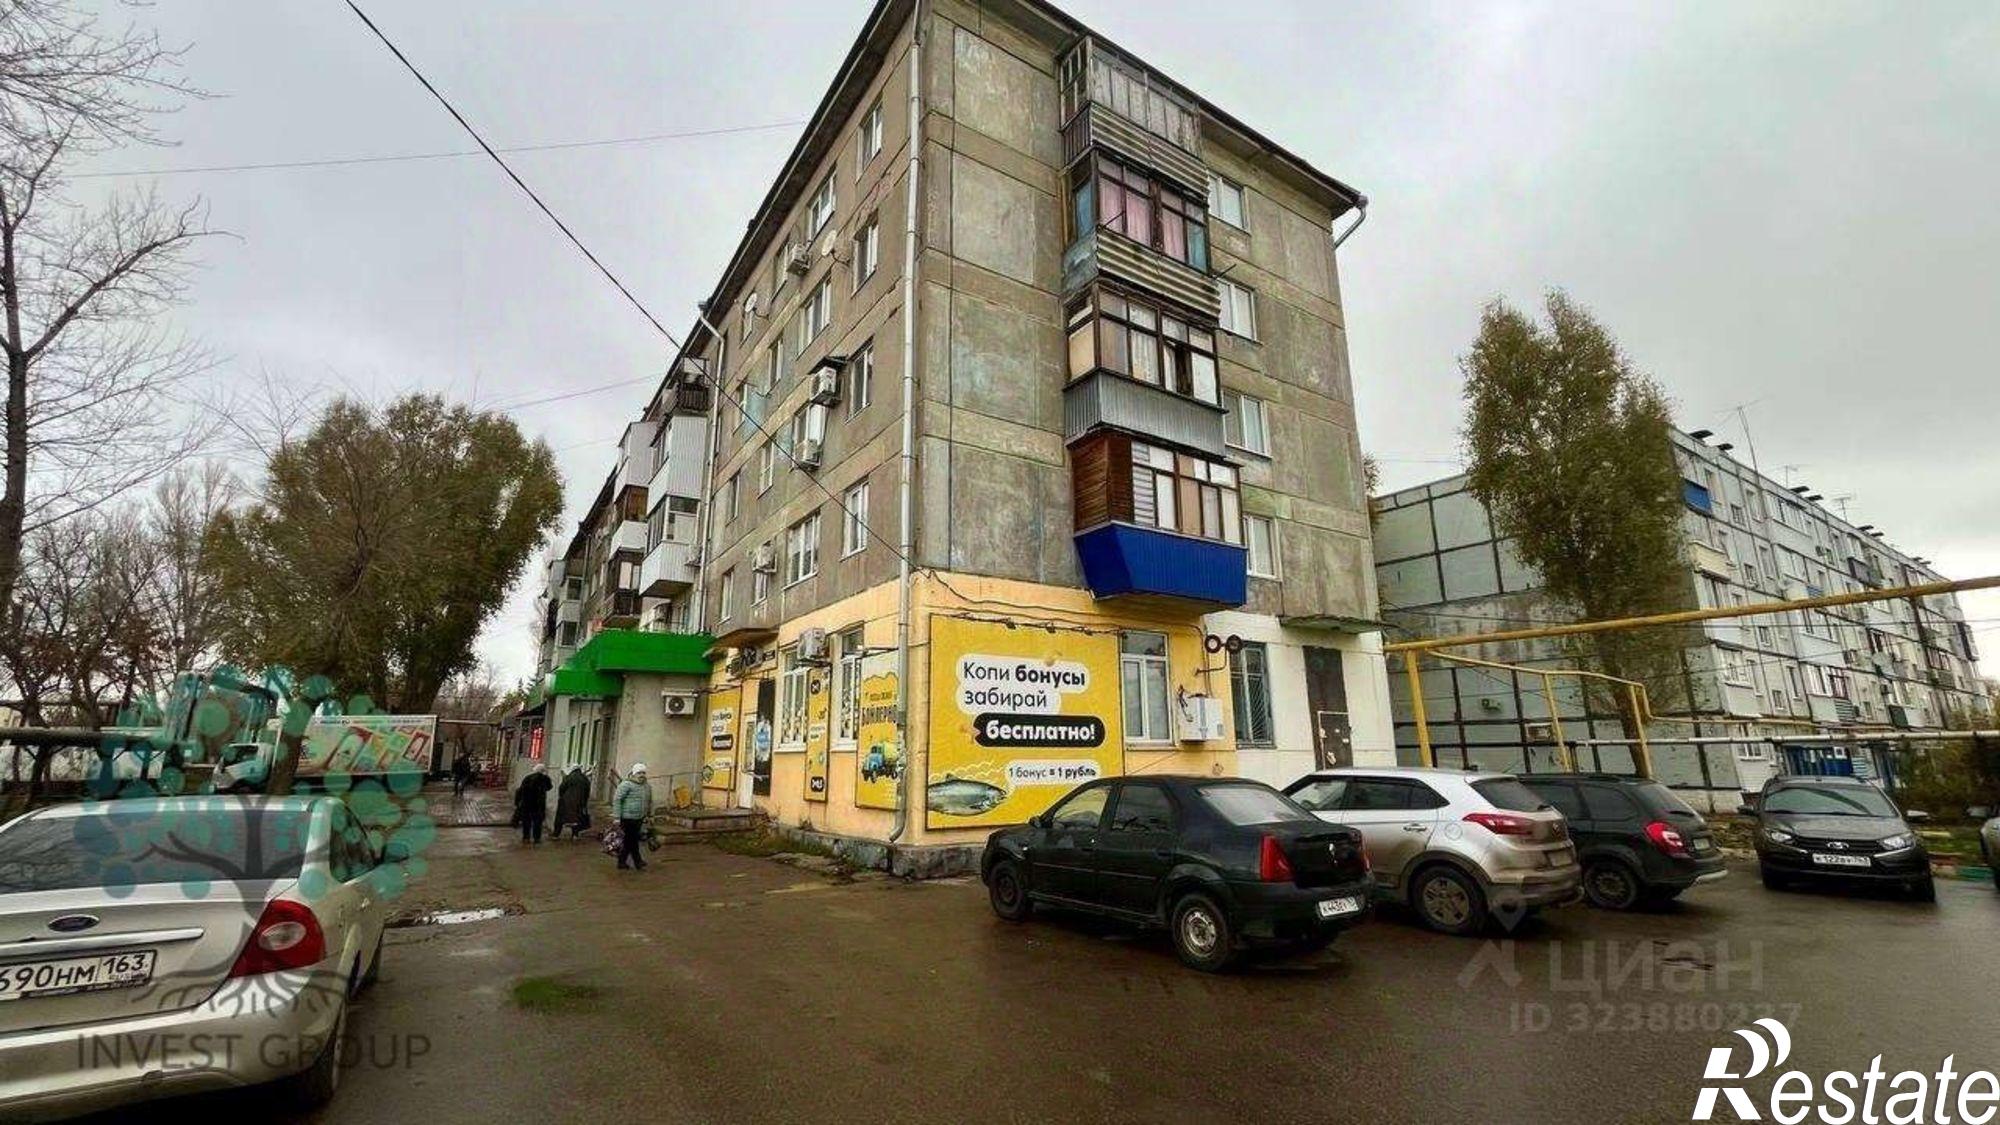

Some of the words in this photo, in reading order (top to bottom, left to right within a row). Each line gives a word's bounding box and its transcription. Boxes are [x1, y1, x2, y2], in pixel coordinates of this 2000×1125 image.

[964, 662, 1010, 681] Копи
[1015, 665, 1086, 688] бонусы
[964, 686, 1047, 711] забирай
[985, 719, 1096, 741] бесплатно!
[1016, 766, 1047, 779] бонус
[1065, 766, 1096, 779] рубль
[103, 954, 146, 974] 163
